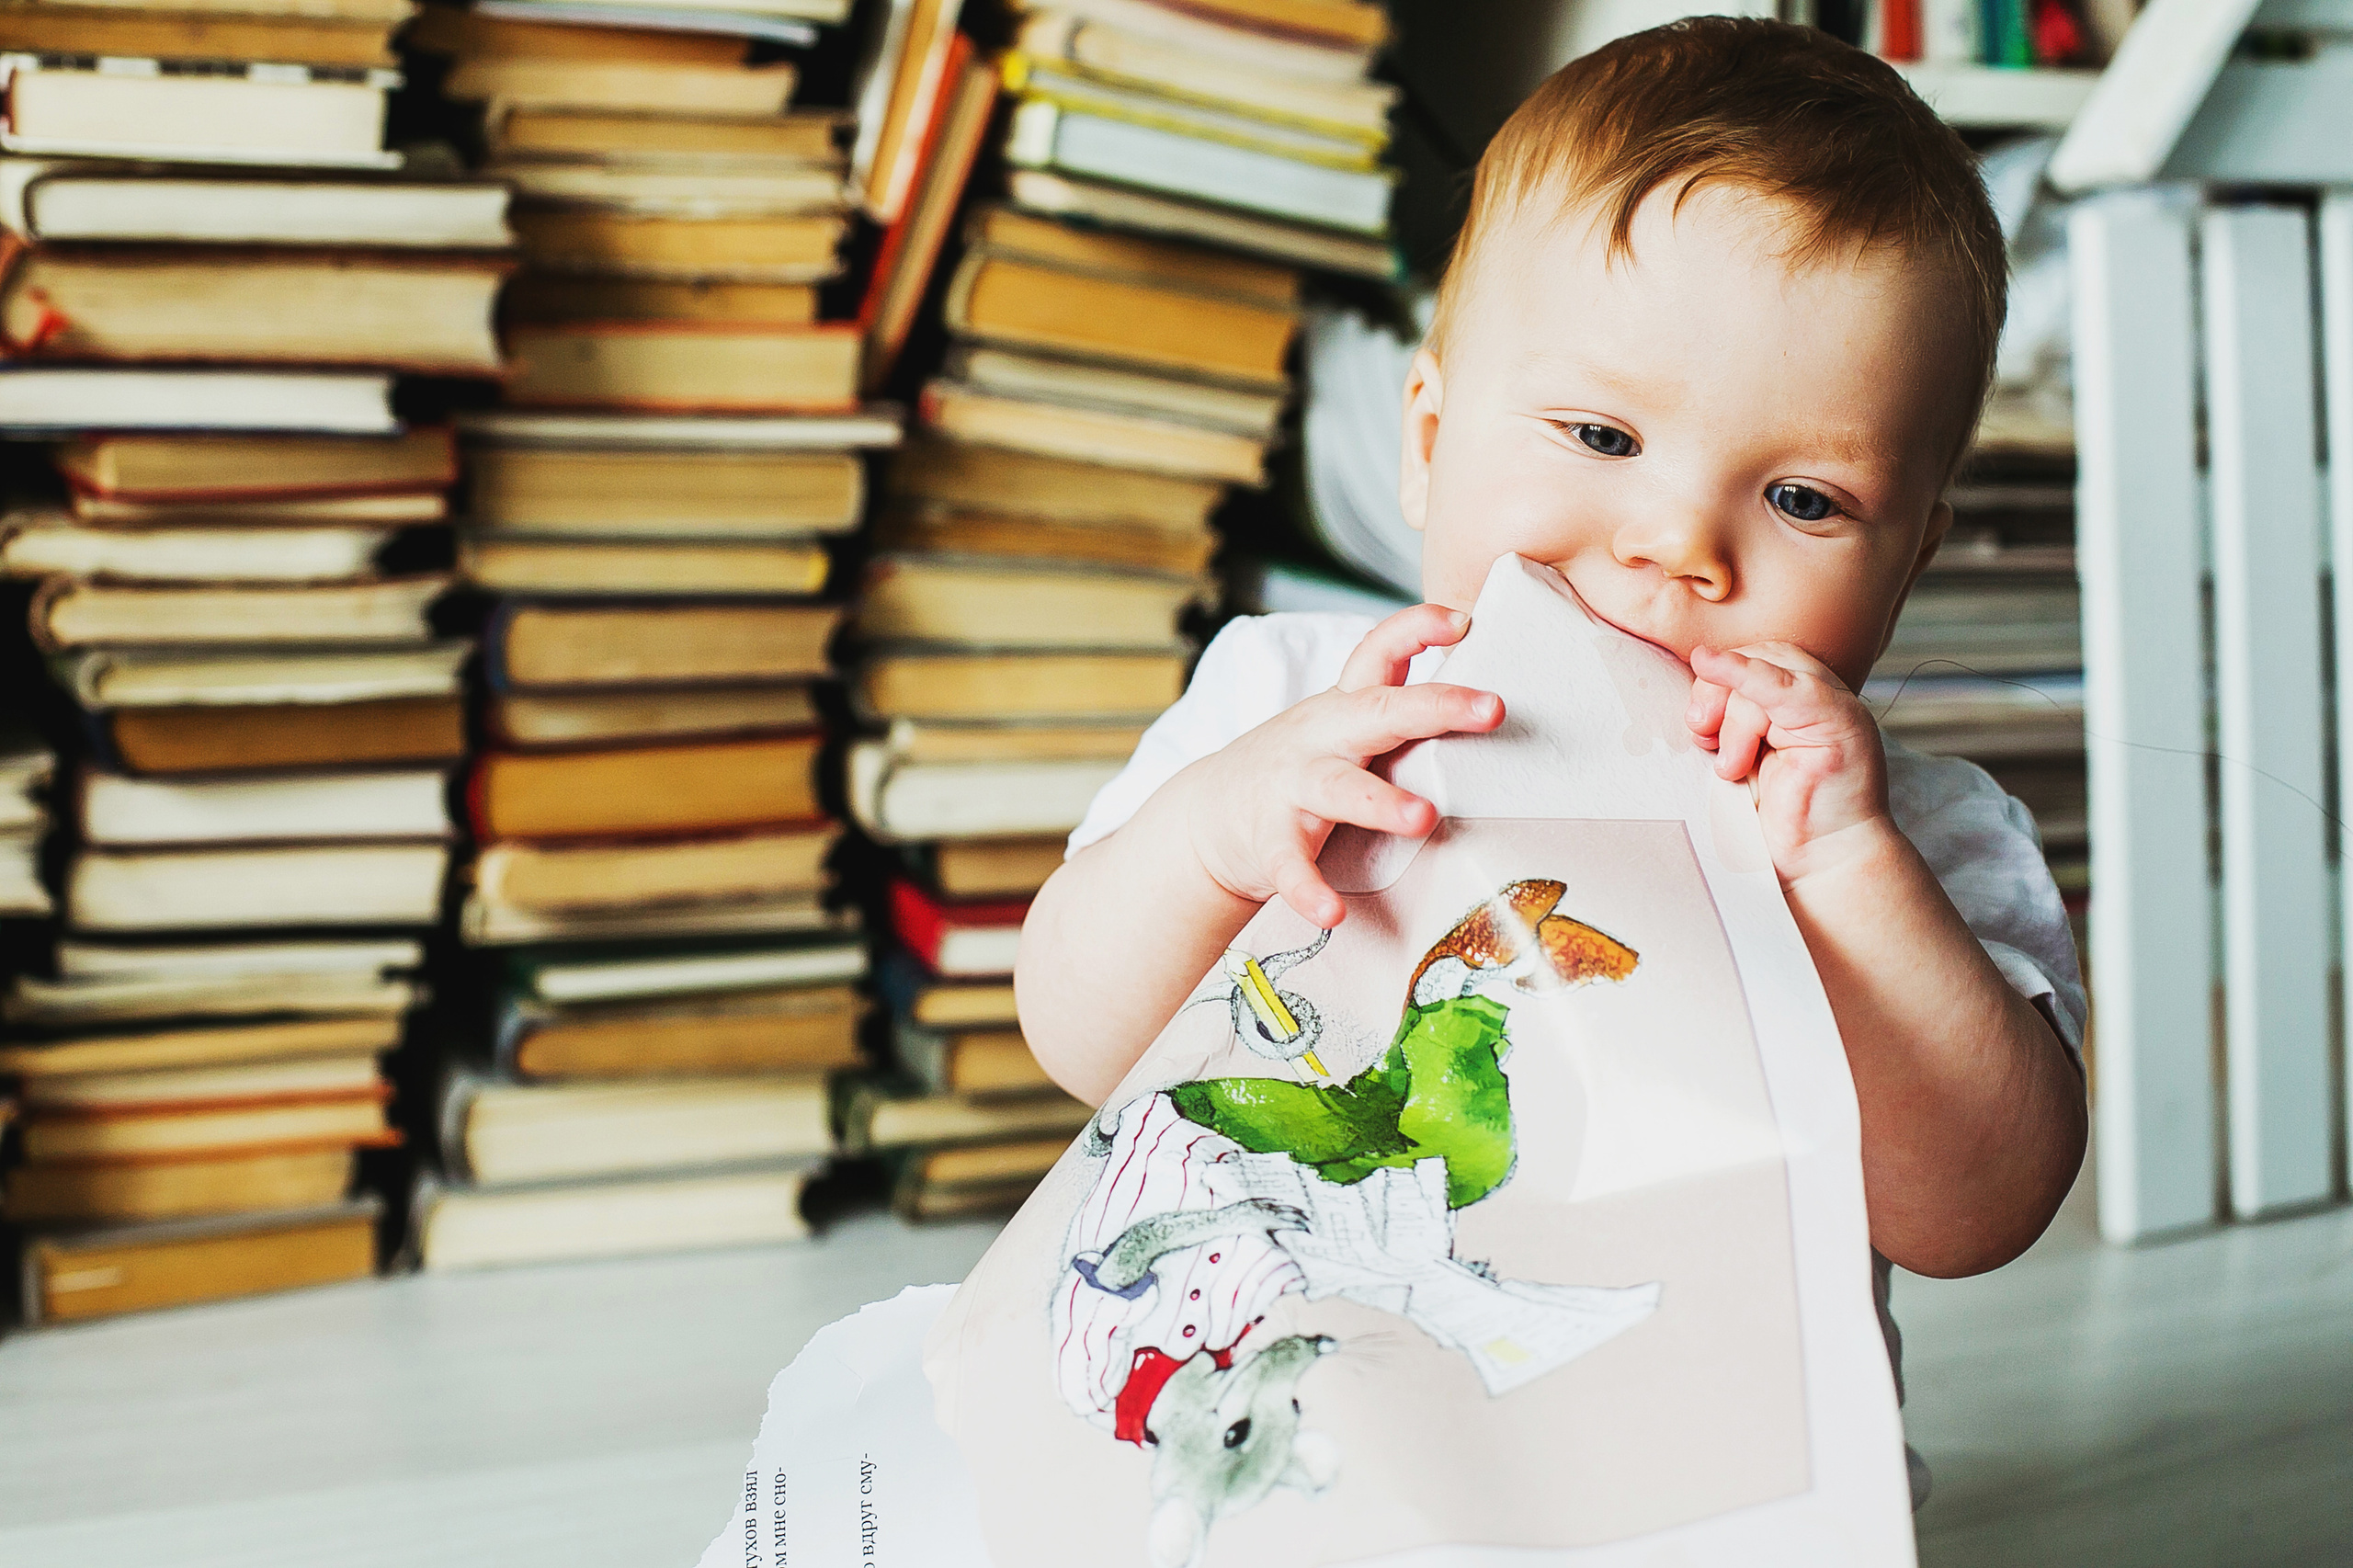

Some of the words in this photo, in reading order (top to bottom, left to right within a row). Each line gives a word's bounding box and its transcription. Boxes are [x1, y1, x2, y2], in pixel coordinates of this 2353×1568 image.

[745, 1470, 757, 1513] взял
[774, 1467, 787, 1506] сно-
[860, 1452, 877, 1494] сму-
[774, 1509, 787, 1547] мне
[860, 1500, 878, 1556] вдруг
[775, 1551, 787, 1568] м
